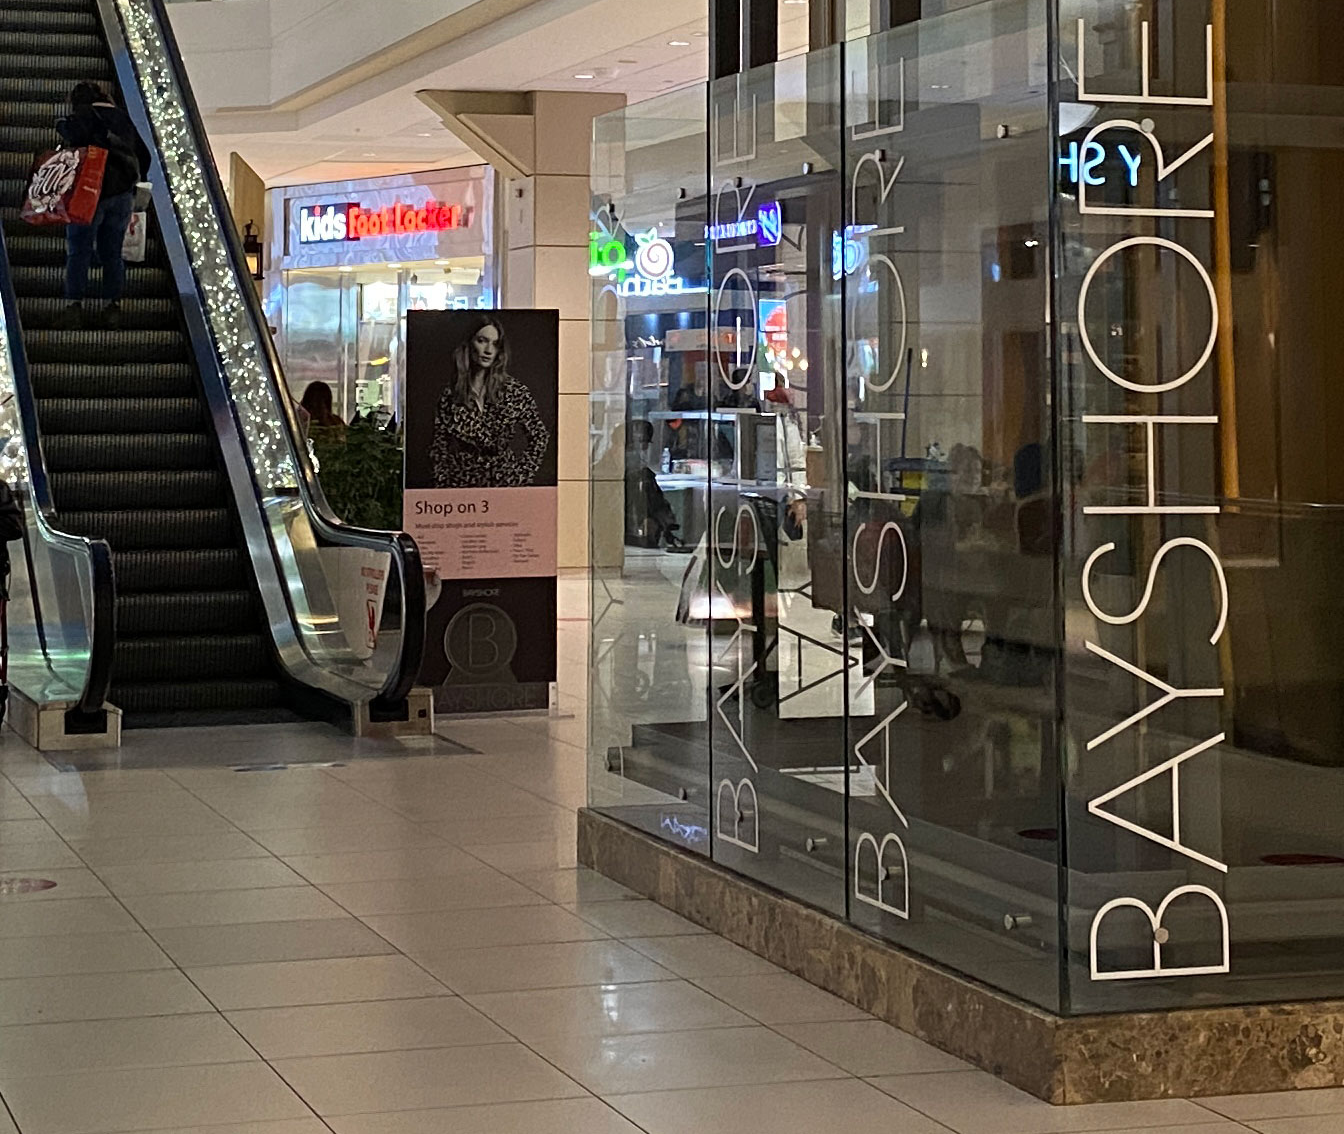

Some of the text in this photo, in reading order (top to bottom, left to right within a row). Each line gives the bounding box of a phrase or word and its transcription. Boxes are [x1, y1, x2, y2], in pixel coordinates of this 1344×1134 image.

[299, 199, 463, 243] kids Foot Locker
[415, 500, 490, 517] Shop on 3
[714, 93, 760, 854] BAYSHORE
[851, 56, 909, 921] BAYSHORE
[1076, 19, 1231, 982] BAYSHORE
